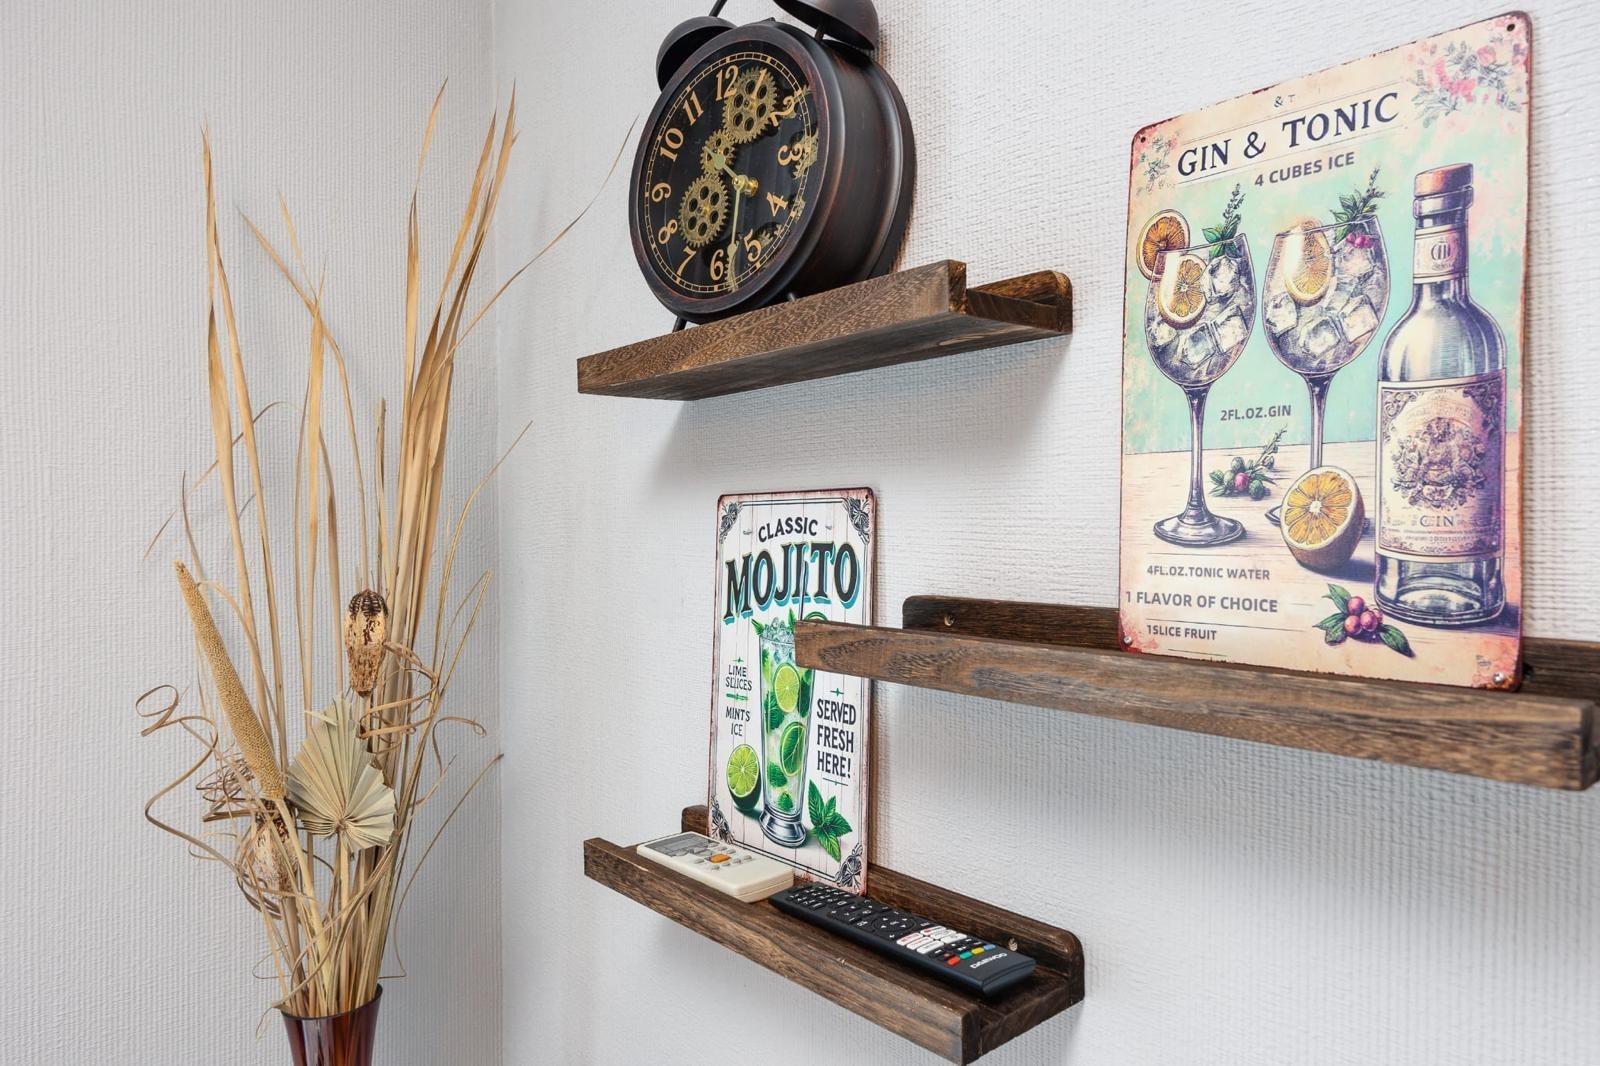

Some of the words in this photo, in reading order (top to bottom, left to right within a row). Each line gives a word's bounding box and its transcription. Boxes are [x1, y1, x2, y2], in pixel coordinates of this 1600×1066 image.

[715, 65, 740, 101] 12
[750, 67, 768, 100] 1
[682, 91, 704, 125] 11
[768, 97, 796, 127] 2
[660, 128, 684, 163] 10
[1177, 138, 1231, 176] GIN
[1243, 131, 1267, 159] &
[1282, 92, 1399, 148] TONIC
[777, 145, 803, 166] 3
[1254, 174, 1264, 187] 4
[1269, 160, 1322, 184] CUBES
[1328, 151, 1355, 170] ICE
[652, 182, 672, 202] 9
[766, 191, 788, 217] 4
[658, 219, 678, 245] 8
[743, 229, 763, 262] 5
[676, 245, 697, 276] 7
[710, 248, 724, 281] 6
[1220, 404, 1292, 421] 2FL.OZ.GIN
[758, 517, 818, 543] CLASSIC
[723, 541, 861, 625] MOJITO
[1226, 568, 1270, 581] WATER
[1126, 591, 1131, 603] 1
[1136, 591, 1192, 607] FLAVOR
[1197, 595, 1216, 609] OF
[1220, 596, 1278, 613] CHOICE
[1184, 626, 1218, 641] FRUIT
[728, 664, 747, 677] LIME
[725, 706, 750, 722] MINTS
[817, 698, 856, 726] SERVED
[731, 722, 743, 736] ICE
[817, 724, 854, 753] FRESH
[817, 750, 851, 779] HERE!
